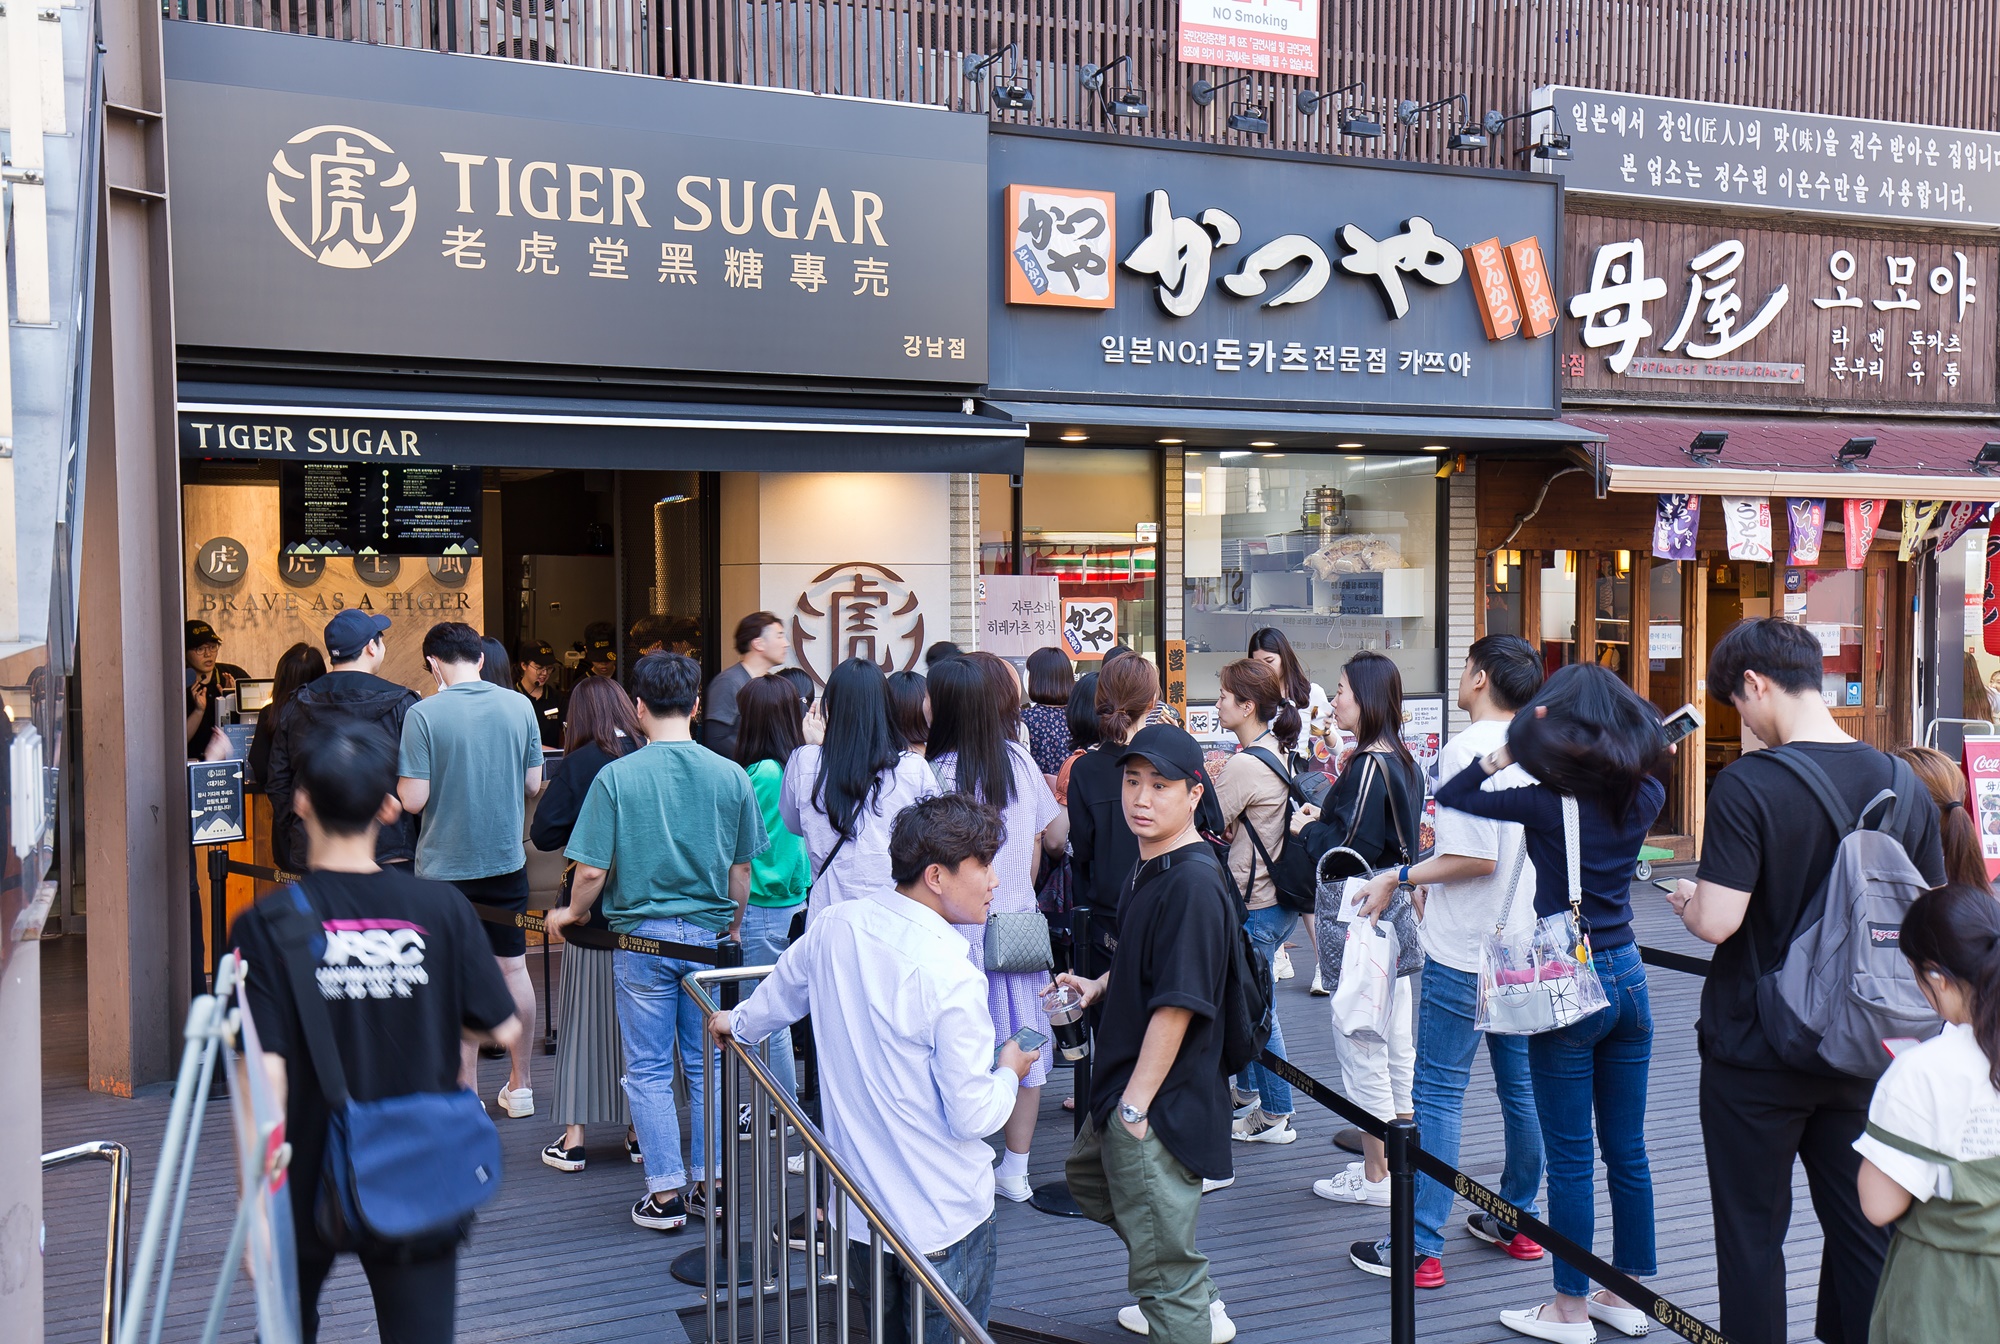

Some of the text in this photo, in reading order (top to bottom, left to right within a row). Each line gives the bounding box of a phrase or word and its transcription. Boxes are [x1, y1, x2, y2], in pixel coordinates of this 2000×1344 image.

[1212, 6, 1231, 20] NO
[1234, 9, 1288, 31] Smoking
[1228, 35, 1236, 47] 제
[1201, 47, 1215, 60] 의거
[1216, 49, 1224, 60] 이
[1281, 57, 1288, 69] 수
[1572, 101, 1645, 139] 일본에서
[1657, 111, 1762, 151] 장인(匠人)의
[1774, 123, 1840, 157] 맛(味)을
[1849, 131, 1883, 161] 전수
[1890, 136, 1941, 168] 받아온
[1619, 153, 1974, 213] 본 업소는 정수된 이온수만을 사용합니다.
[439, 150, 891, 248] TIGER SUGAR
[1119, 188, 1464, 321] かつや
[1477, 245, 1513, 325] とんかつ
[1519, 247, 1551, 322] カツ丼
[1813, 249, 1978, 324] 오모야
[1569, 238, 1790, 375] 母屋
[902, 335, 967, 361] 강남점
[1907, 328, 1963, 354] 돈까츠
[1313, 344, 1387, 374] 전문점
[1398, 349, 1471, 377] 카쯔야
[1632, 361, 1788, 378] JAPANESE RESTAURANT
[1830, 356, 1884, 384] 돈부리
[190, 422, 421, 456] TIGER SUGAR
[1737, 502, 1759, 556] うどん
[1787, 575, 1799, 584] ADT
[201, 591, 472, 612] BRAVE AS A TIGER
[1011, 599, 1056, 616] 자루소바
[987, 619, 1057, 636] 히레카츠 정식
[524, 915, 536, 925] TIGER
[629, 936, 660, 949] TIGER SUGAR
[1470, 1182, 1518, 1220] TIGER SUGAR
[1674, 1310, 1702, 1336] TIGER
[1704, 1329, 1729, 1344] SUG
